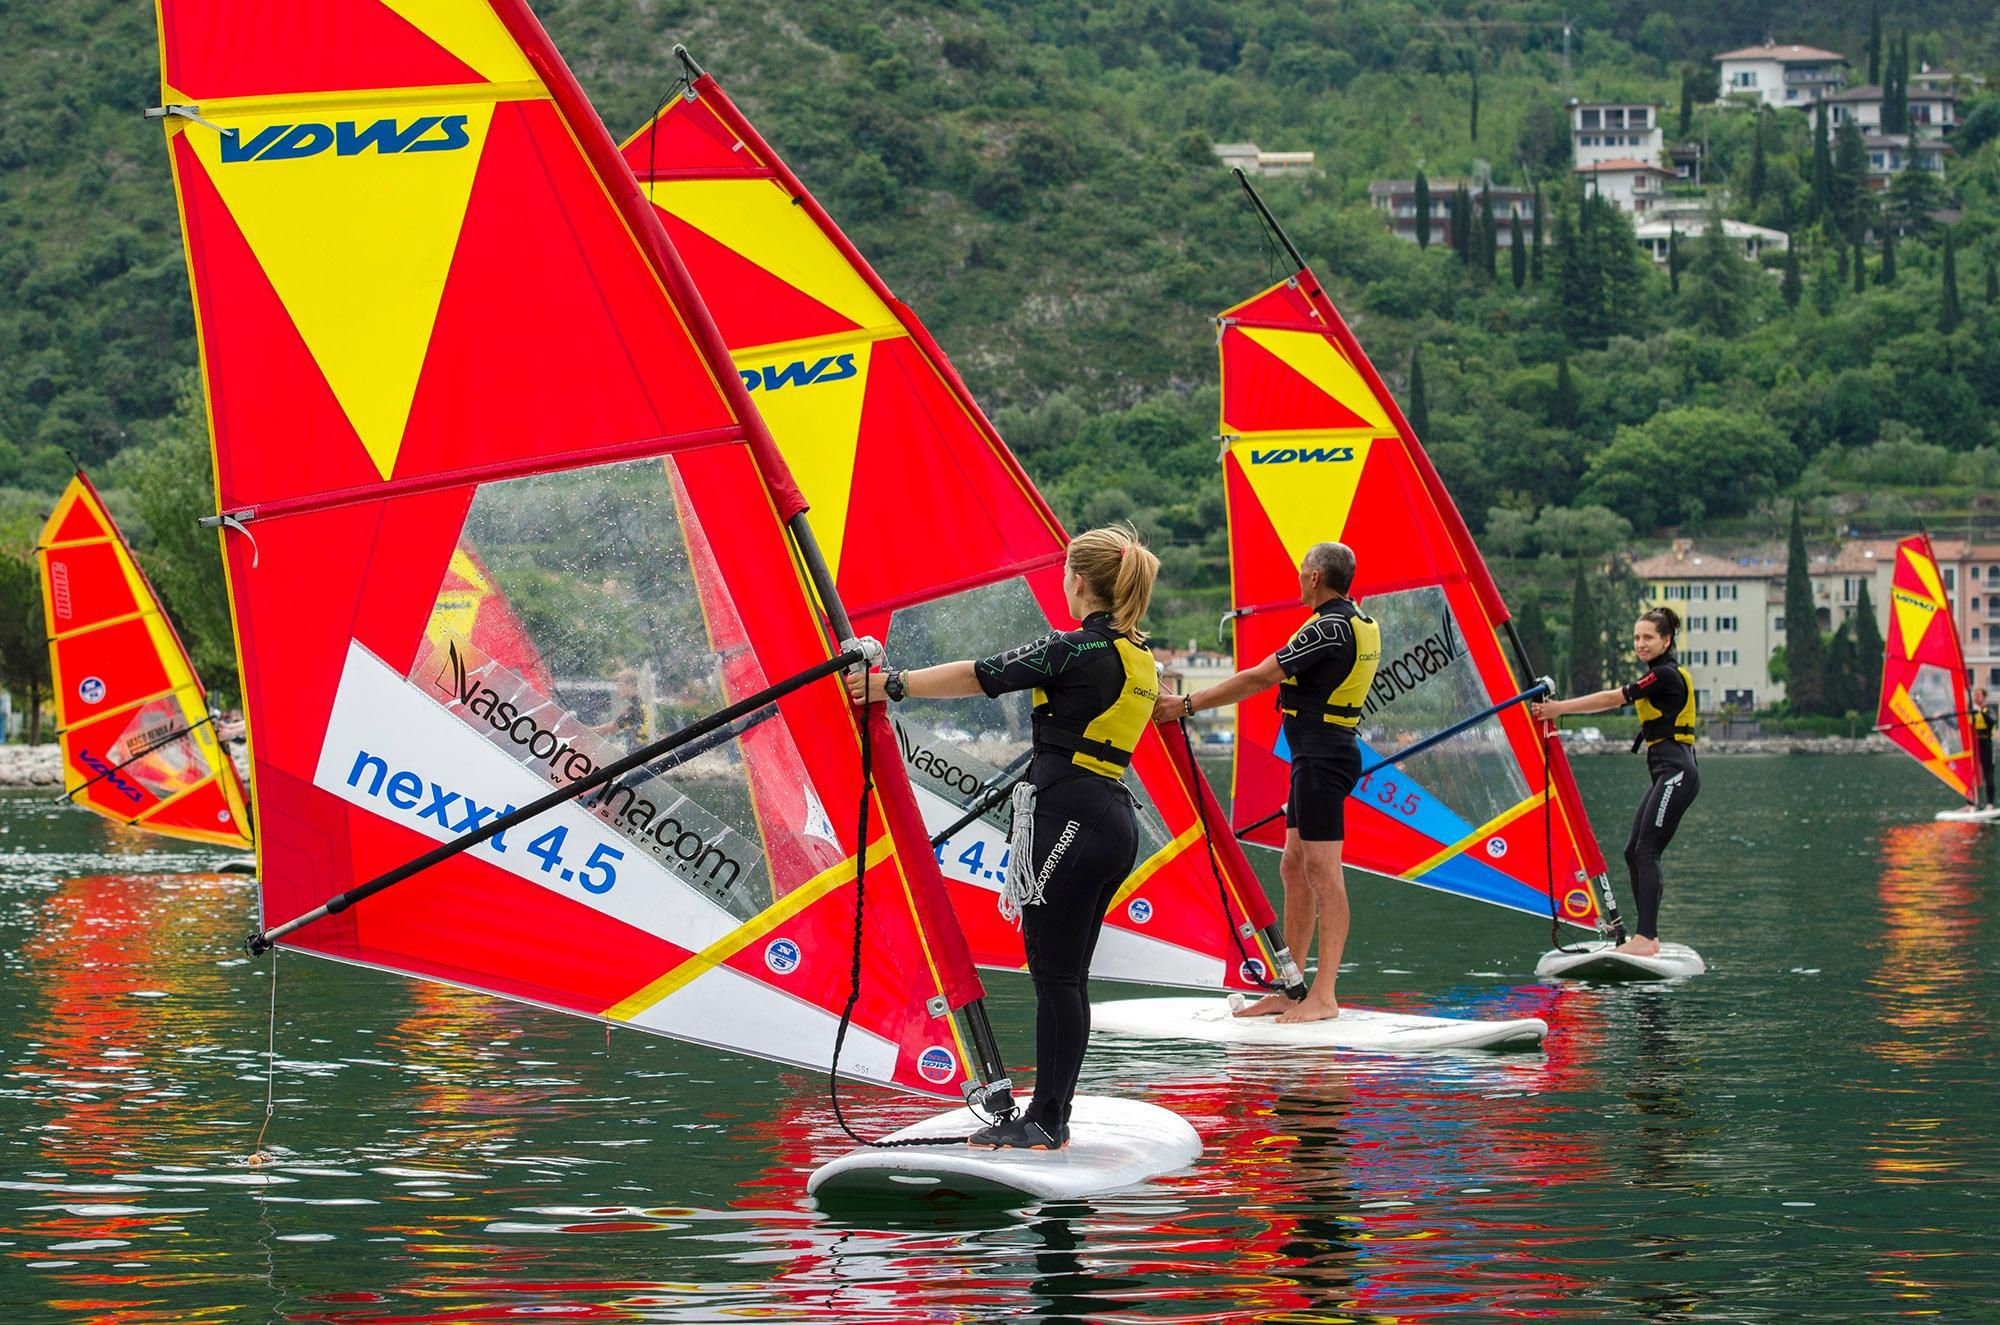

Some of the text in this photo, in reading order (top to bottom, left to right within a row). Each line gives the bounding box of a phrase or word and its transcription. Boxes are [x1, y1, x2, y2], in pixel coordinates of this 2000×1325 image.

[220, 115, 470, 163] VDWS
[1251, 447, 1354, 464] VDWS
[1078, 641, 1107, 651] ELEMENT
[80, 749, 143, 802] VDWS
[1377, 782, 1421, 816] 3.5
[346, 750, 625, 894] nexxt 4.5
[1033, 820, 1080, 900] vascorenna.com
[921, 1060, 953, 1070] VDWS
